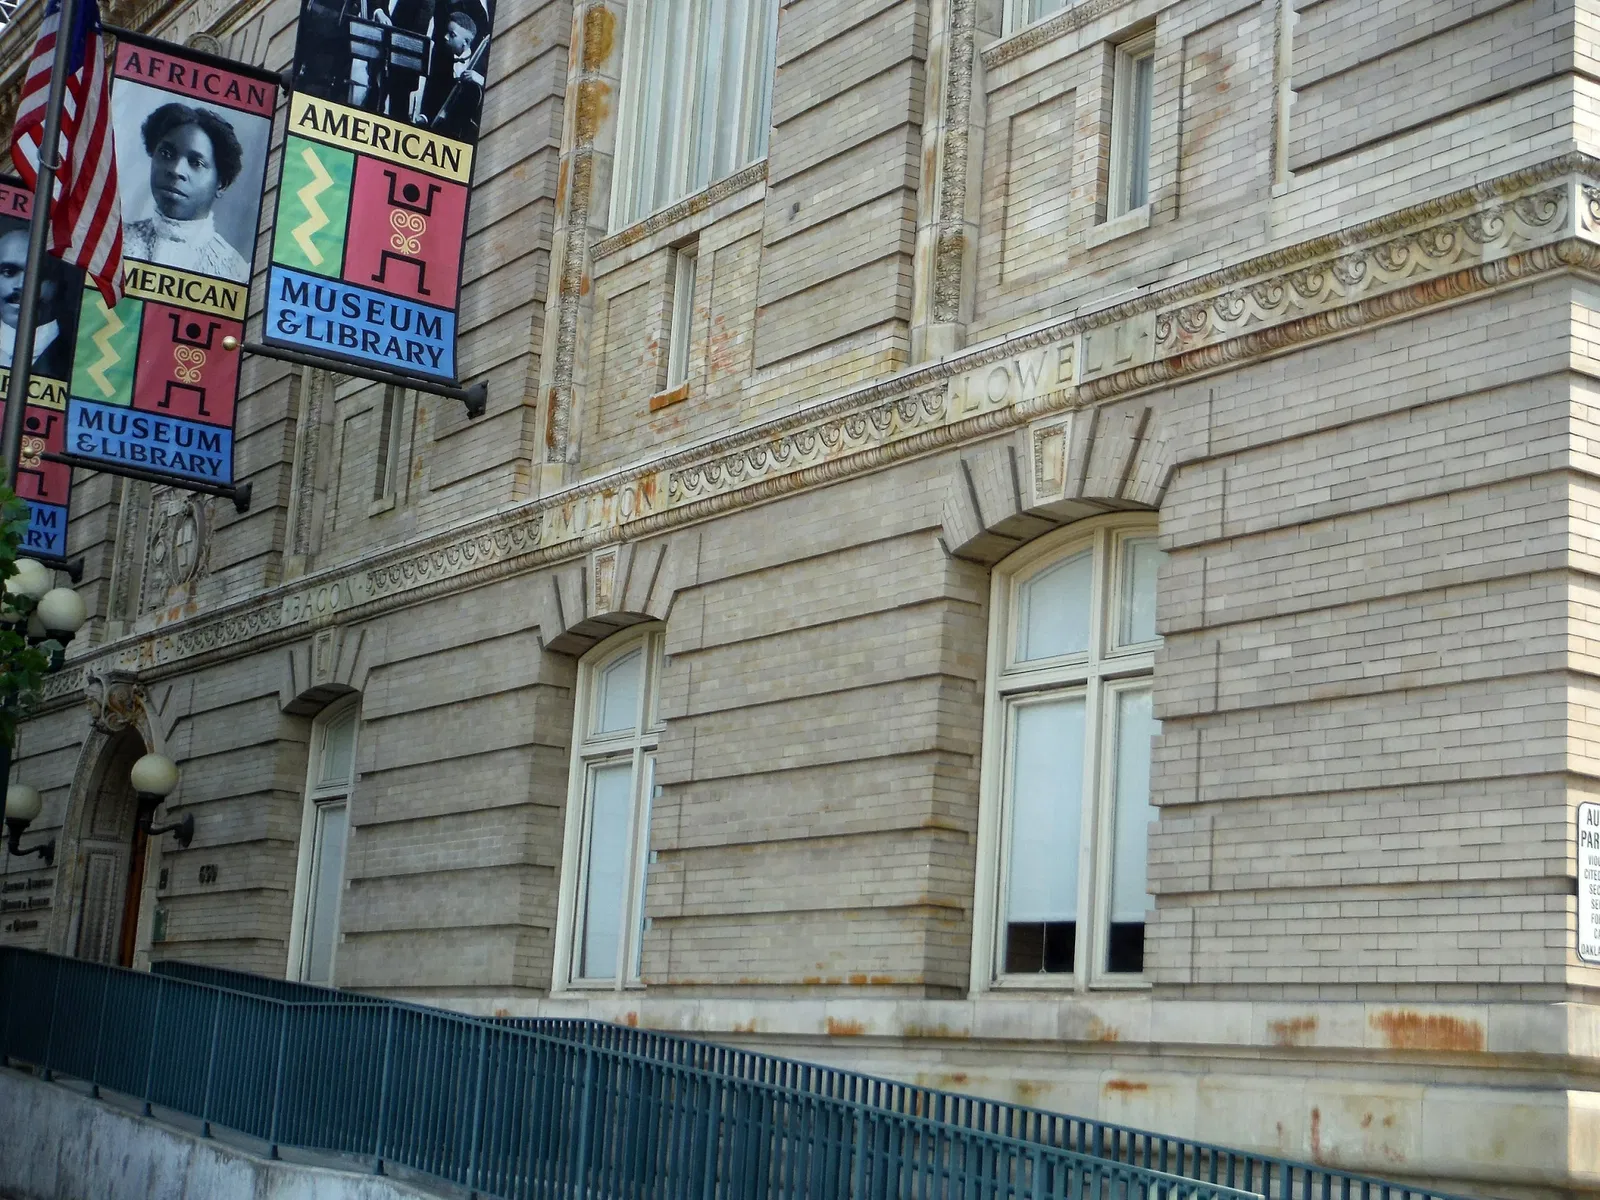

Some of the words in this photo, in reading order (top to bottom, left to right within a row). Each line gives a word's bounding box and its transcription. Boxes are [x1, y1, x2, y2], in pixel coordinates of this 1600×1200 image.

[123, 52, 266, 108] AFRICAN
[298, 103, 462, 173] AMERICAN
[124, 267, 239, 312] MERICAN
[280, 276, 443, 341] MUSEUM
[961, 326, 1133, 414] LOWELL
[78, 406, 223, 454] MUSEUM
